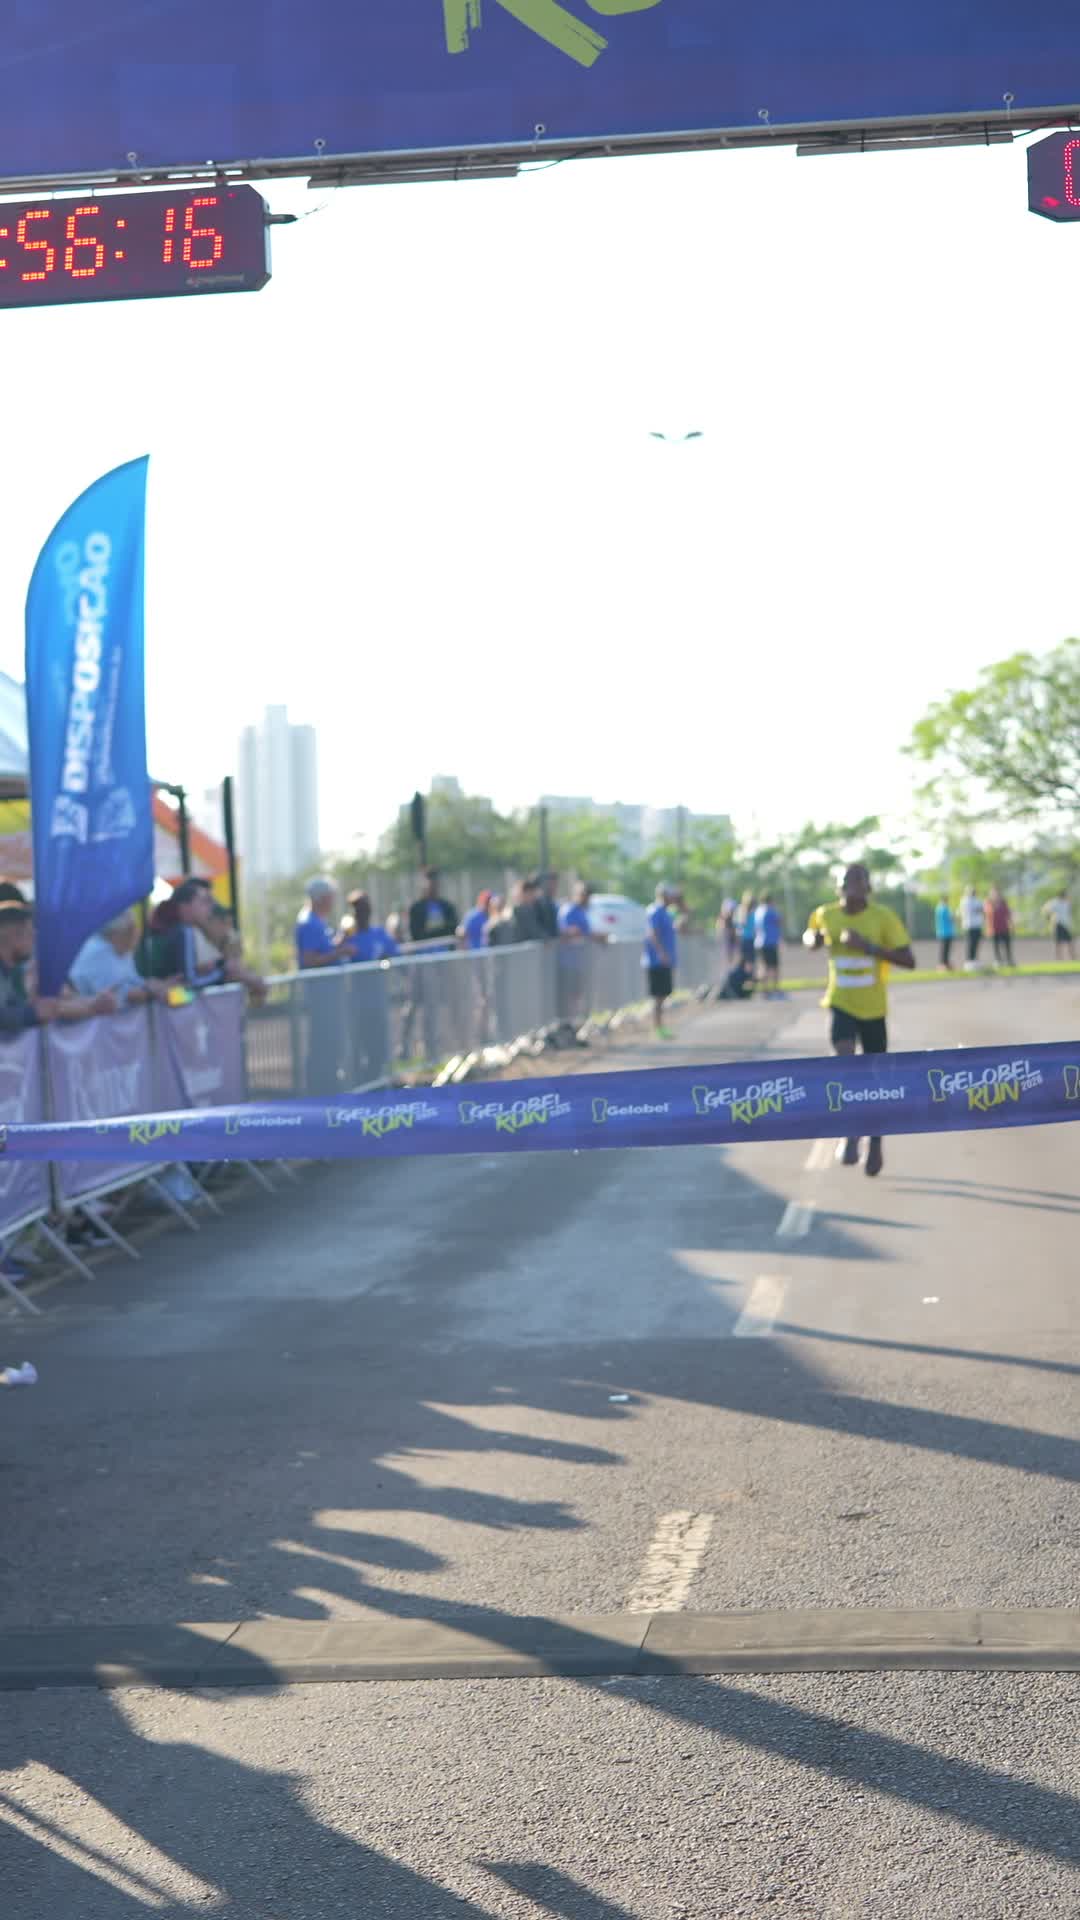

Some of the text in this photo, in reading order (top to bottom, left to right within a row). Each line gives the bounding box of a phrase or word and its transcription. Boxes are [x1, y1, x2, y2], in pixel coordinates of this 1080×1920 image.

[940, 1060, 1041, 1095] GELOBEL
[704, 1076, 803, 1109] GELOBEL
[842, 1086, 905, 1102] Gelobel
[968, 1081, 1019, 1111] RUN
[336, 1101, 429, 1123] GELOBEL
[469, 1093, 567, 1120] GELOBEL
[606, 1102, 669, 1116] Gelobel
[731, 1095, 782, 1124] RUN
[129, 1119, 181, 1144] RUN
[361, 1113, 414, 1137] RUN
[496, 1110, 547, 1133] RUN
